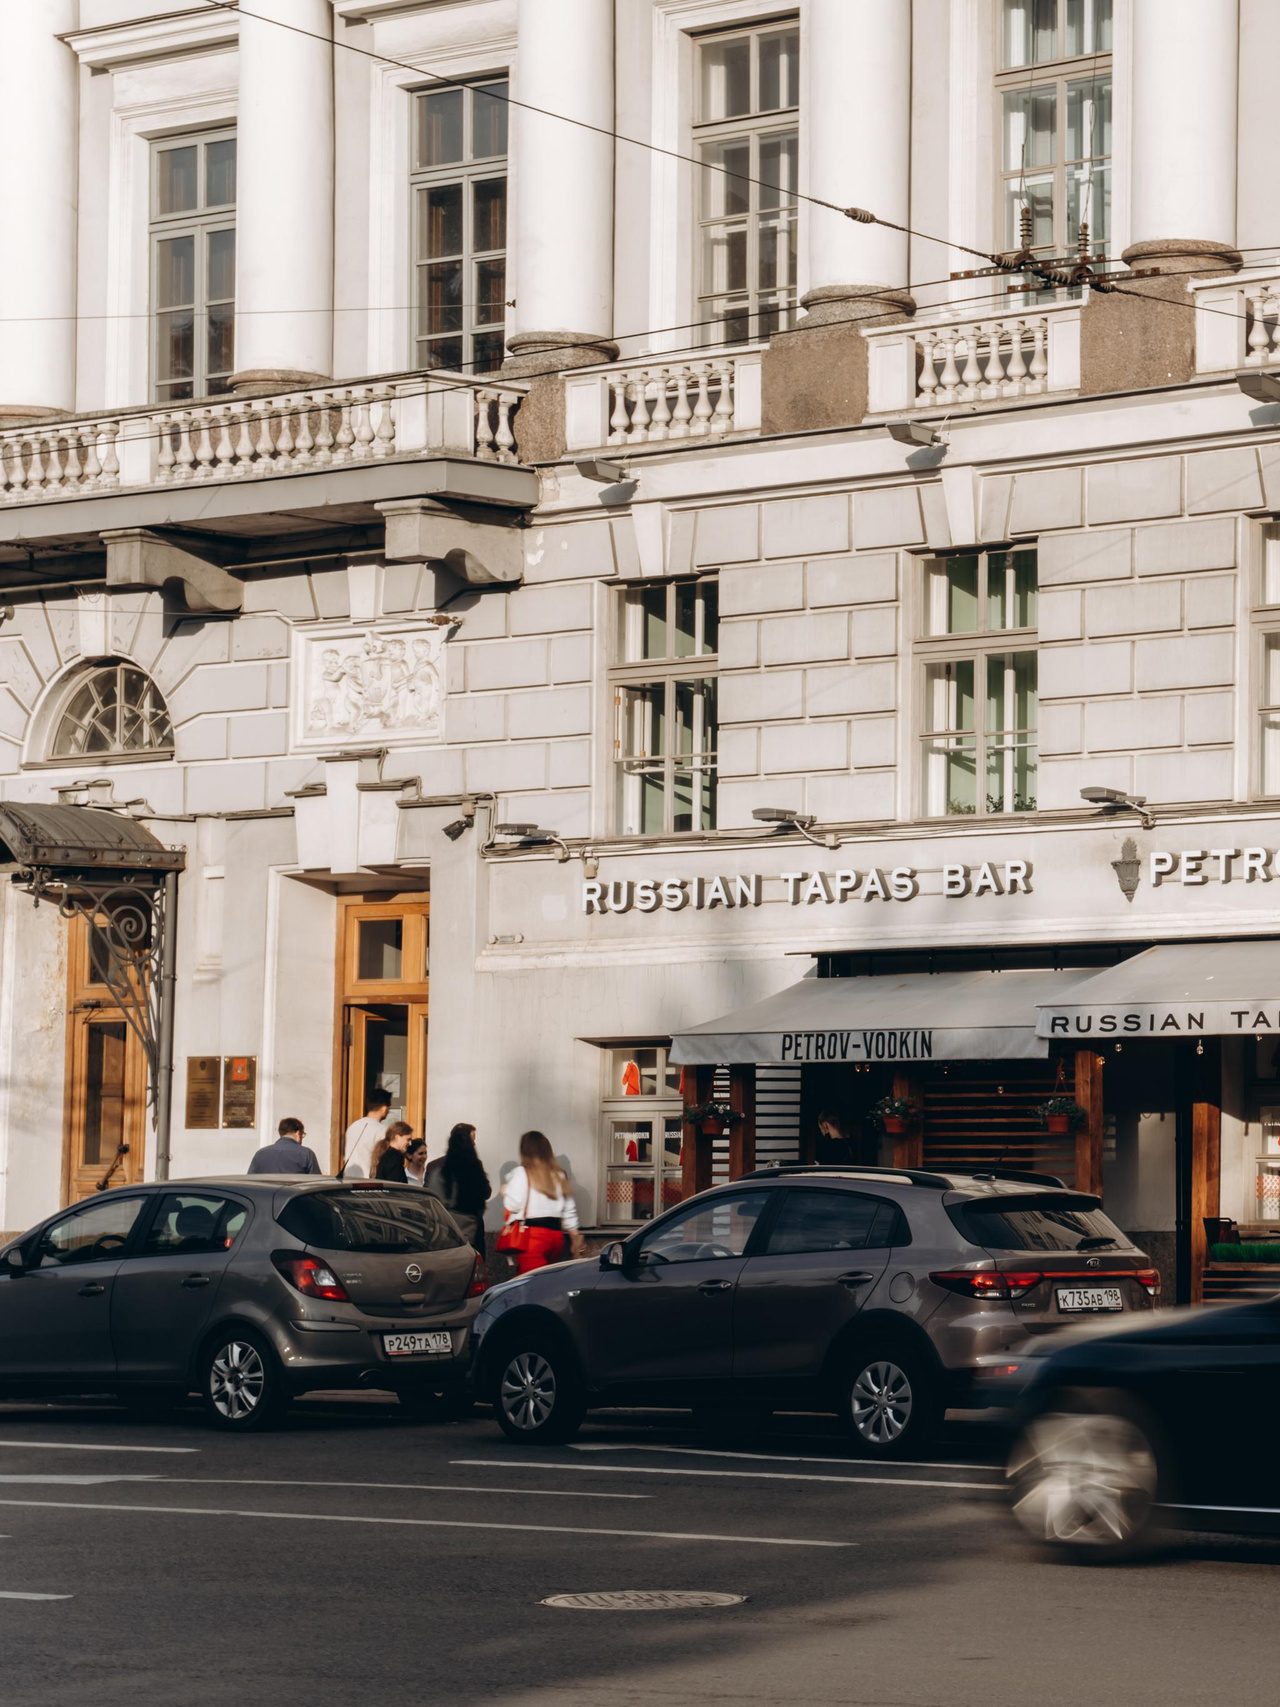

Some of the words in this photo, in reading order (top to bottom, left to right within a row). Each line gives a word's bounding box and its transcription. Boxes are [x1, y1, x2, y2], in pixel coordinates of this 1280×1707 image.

[582, 874, 761, 913] RUSSIAN
[781, 867, 918, 903] TAPAS
[943, 860, 1033, 897] BAR
[1051, 1012, 1205, 1033] RUSSIAN
[781, 1031, 933, 1060] PETROV-VODKIN
